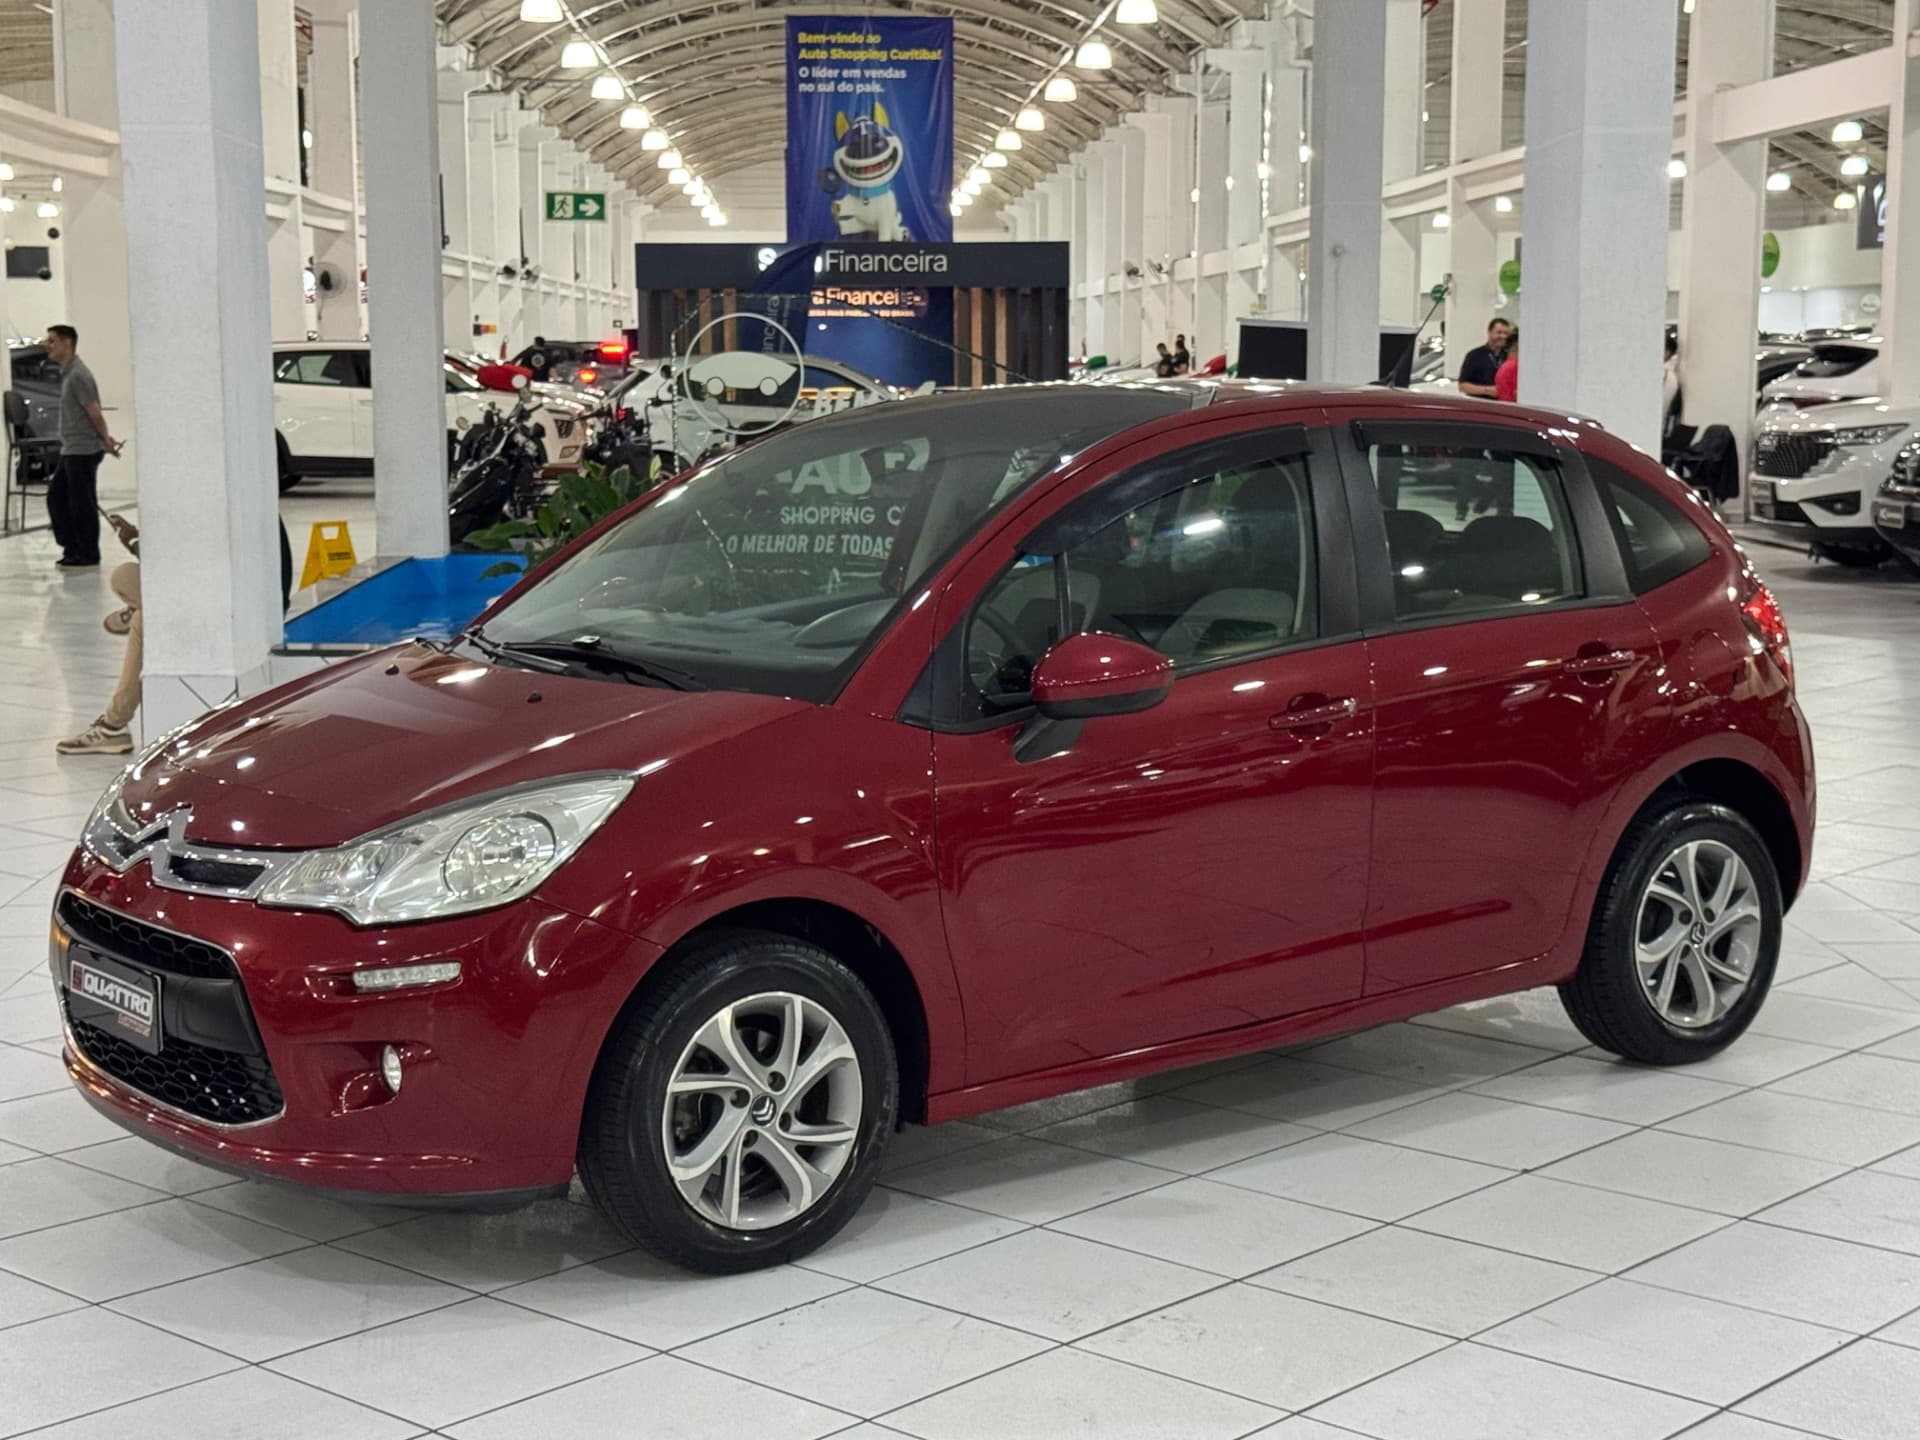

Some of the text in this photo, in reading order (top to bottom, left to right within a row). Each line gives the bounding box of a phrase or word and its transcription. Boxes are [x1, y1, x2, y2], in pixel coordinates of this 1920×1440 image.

[798, 32, 881, 44] Bem-vindo ao
[798, 50, 828, 60] Auto
[830, 49, 888, 61] Shopping
[799, 66, 907, 78] O líder em vendas
[799, 82, 815, 92] no
[817, 82, 835, 92] sul
[837, 82, 854, 92] do
[825, 249, 948, 273] Financeira
[780, 505, 876, 525] SHOPPING
[726, 535, 739, 555] O
[741, 534, 809, 554] MELHOR
[814, 535, 836, 554] DE
